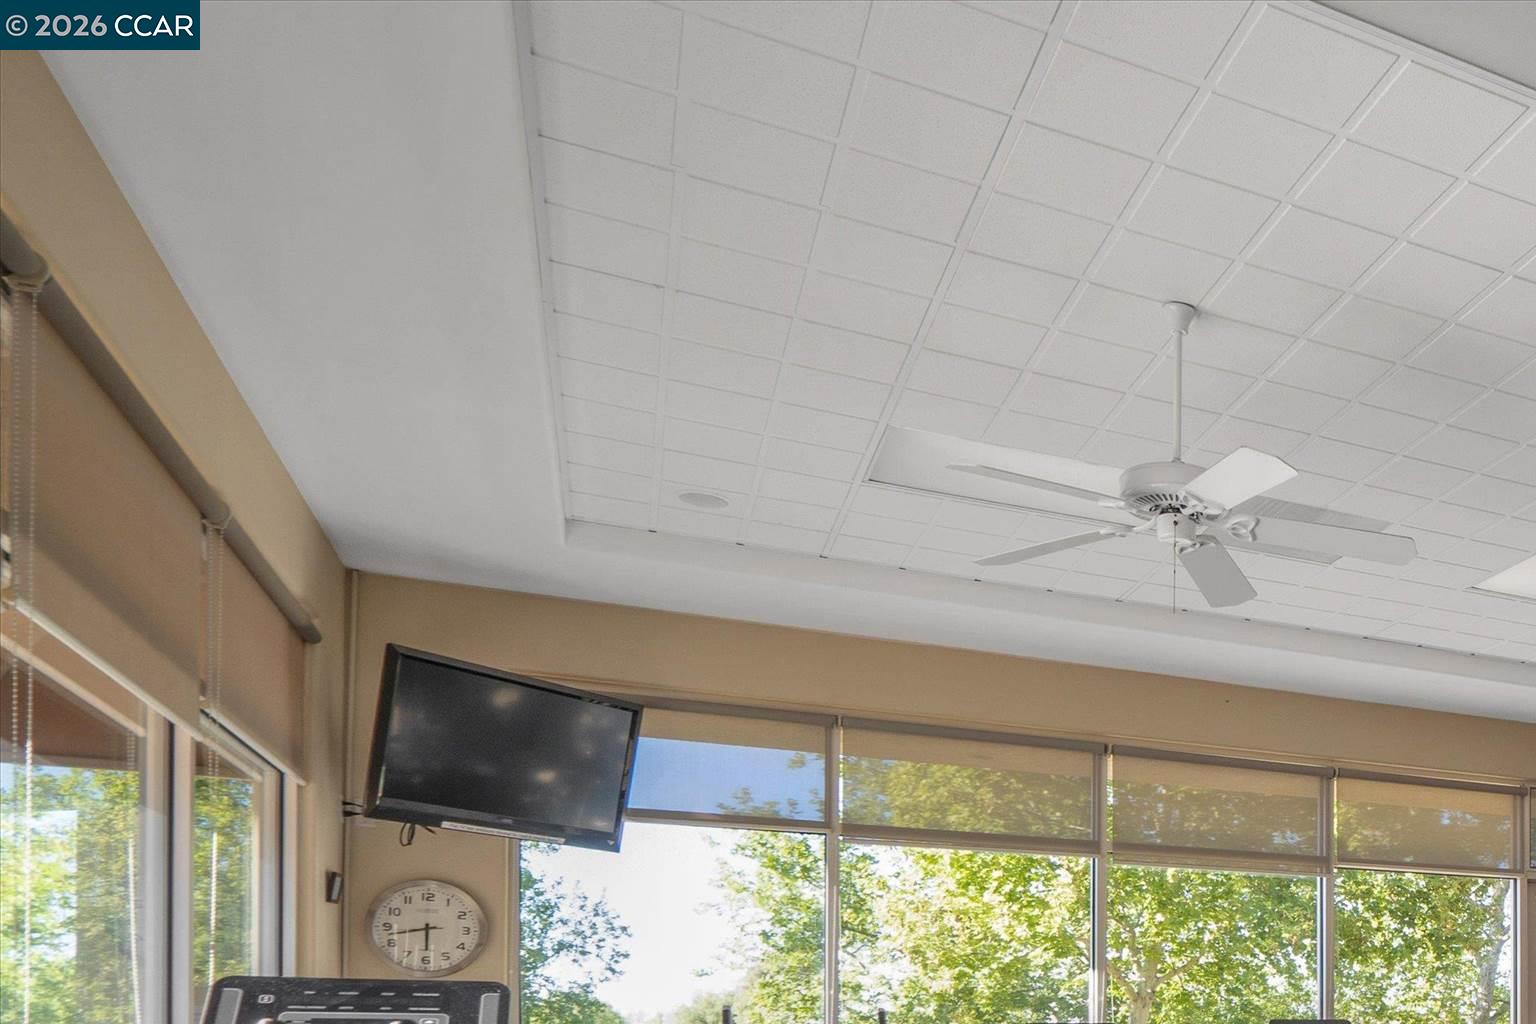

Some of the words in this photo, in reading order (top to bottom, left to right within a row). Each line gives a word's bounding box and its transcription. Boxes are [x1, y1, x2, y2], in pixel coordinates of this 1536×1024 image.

[403, 896, 412, 905] 11
[421, 893, 436, 902] 12
[388, 907, 401, 917] 10
[457, 911, 467, 920] 2
[421, 956, 431, 965] 6
